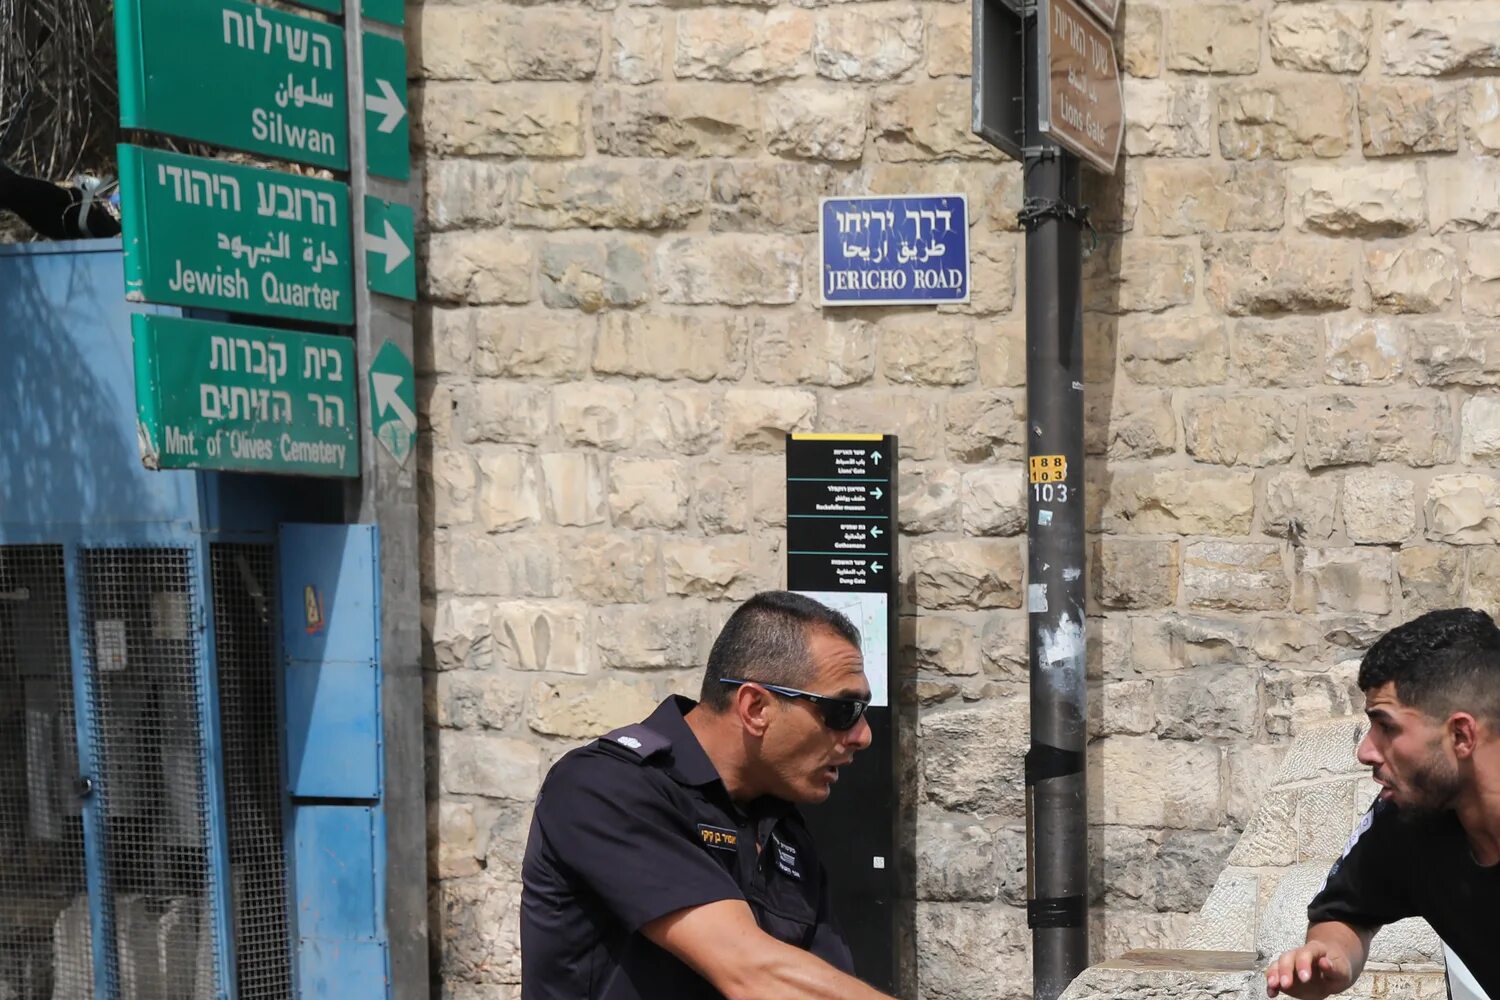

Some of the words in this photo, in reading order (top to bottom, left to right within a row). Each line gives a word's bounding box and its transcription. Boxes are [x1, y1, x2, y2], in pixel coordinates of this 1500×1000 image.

[222, 8, 333, 70] השילוח
[1054, 6, 1086, 58] האריות
[1089, 34, 1109, 76] שער
[275, 74, 334, 109] سلوان
[252, 108, 336, 156] Silwan
[1060, 92, 1083, 132] Lions
[1086, 112, 1106, 147] Gate
[158, 164, 241, 213] היהודי
[256, 181, 337, 228] הרובע
[836, 210, 895, 233] יריחו
[905, 209, 952, 240] דרך
[216, 230, 290, 269] اليهود
[302, 237, 339, 274] حارة
[842, 240, 888, 264] اريحا
[896, 239, 946, 265] طريق
[168, 259, 250, 301] Jewish
[261, 272, 340, 312] Quarter
[827, 270, 907, 295] JERICHO
[914, 269, 963, 290] ROAD
[209, 335, 287, 385] קברות
[303, 345, 343, 382] בית
[199, 384, 293, 424] הזיתים
[308, 393, 345, 428] הר
[165, 425, 198, 457] Mnt.
[206, 429, 224, 457] of
[230, 430, 273, 462] Olives
[280, 432, 346, 470] Cemetery
[1032, 458, 1062, 468] 188
[1032, 470, 1063, 481] 103
[1034, 483, 1068, 503] 103
